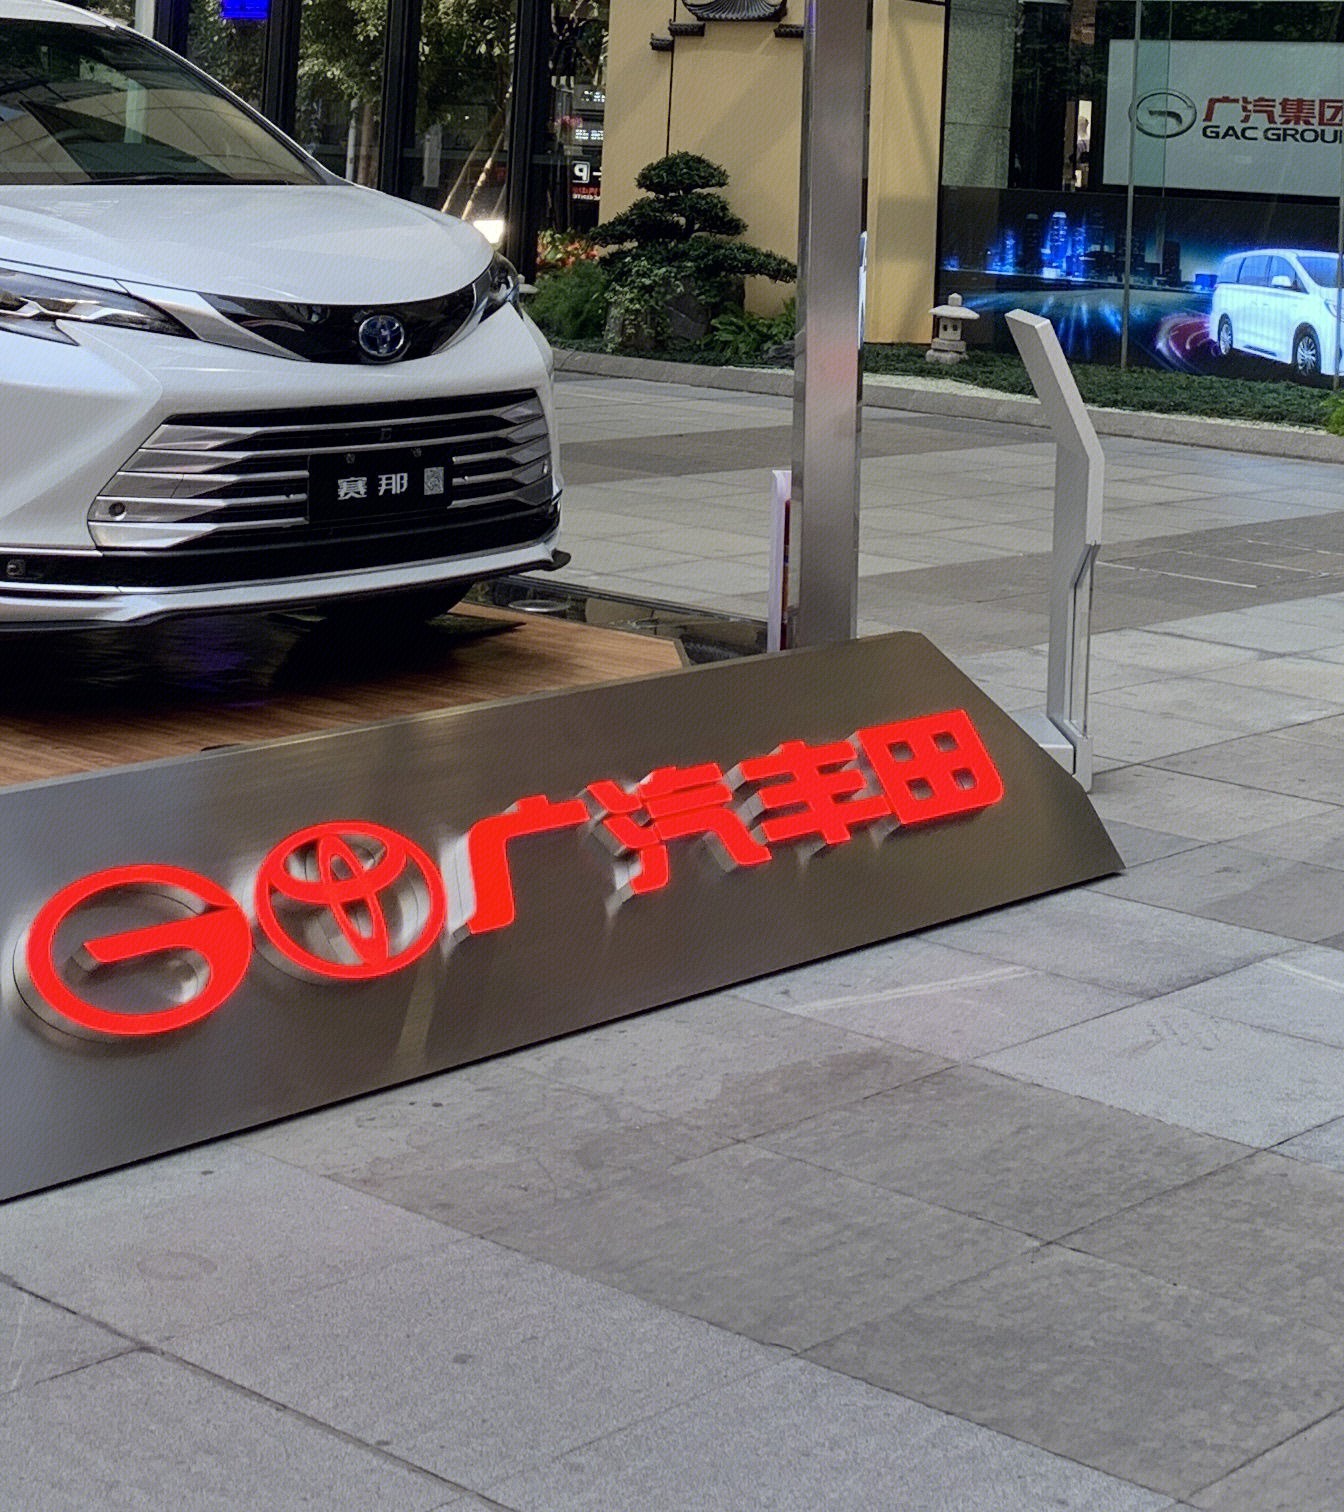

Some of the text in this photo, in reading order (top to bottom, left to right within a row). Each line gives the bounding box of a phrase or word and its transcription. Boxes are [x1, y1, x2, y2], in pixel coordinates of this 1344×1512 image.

[1202, 125, 1258, 141] GAC
[337, 473, 408, 500] 赛那
[467, 708, 1005, 935] 广汽丰田
